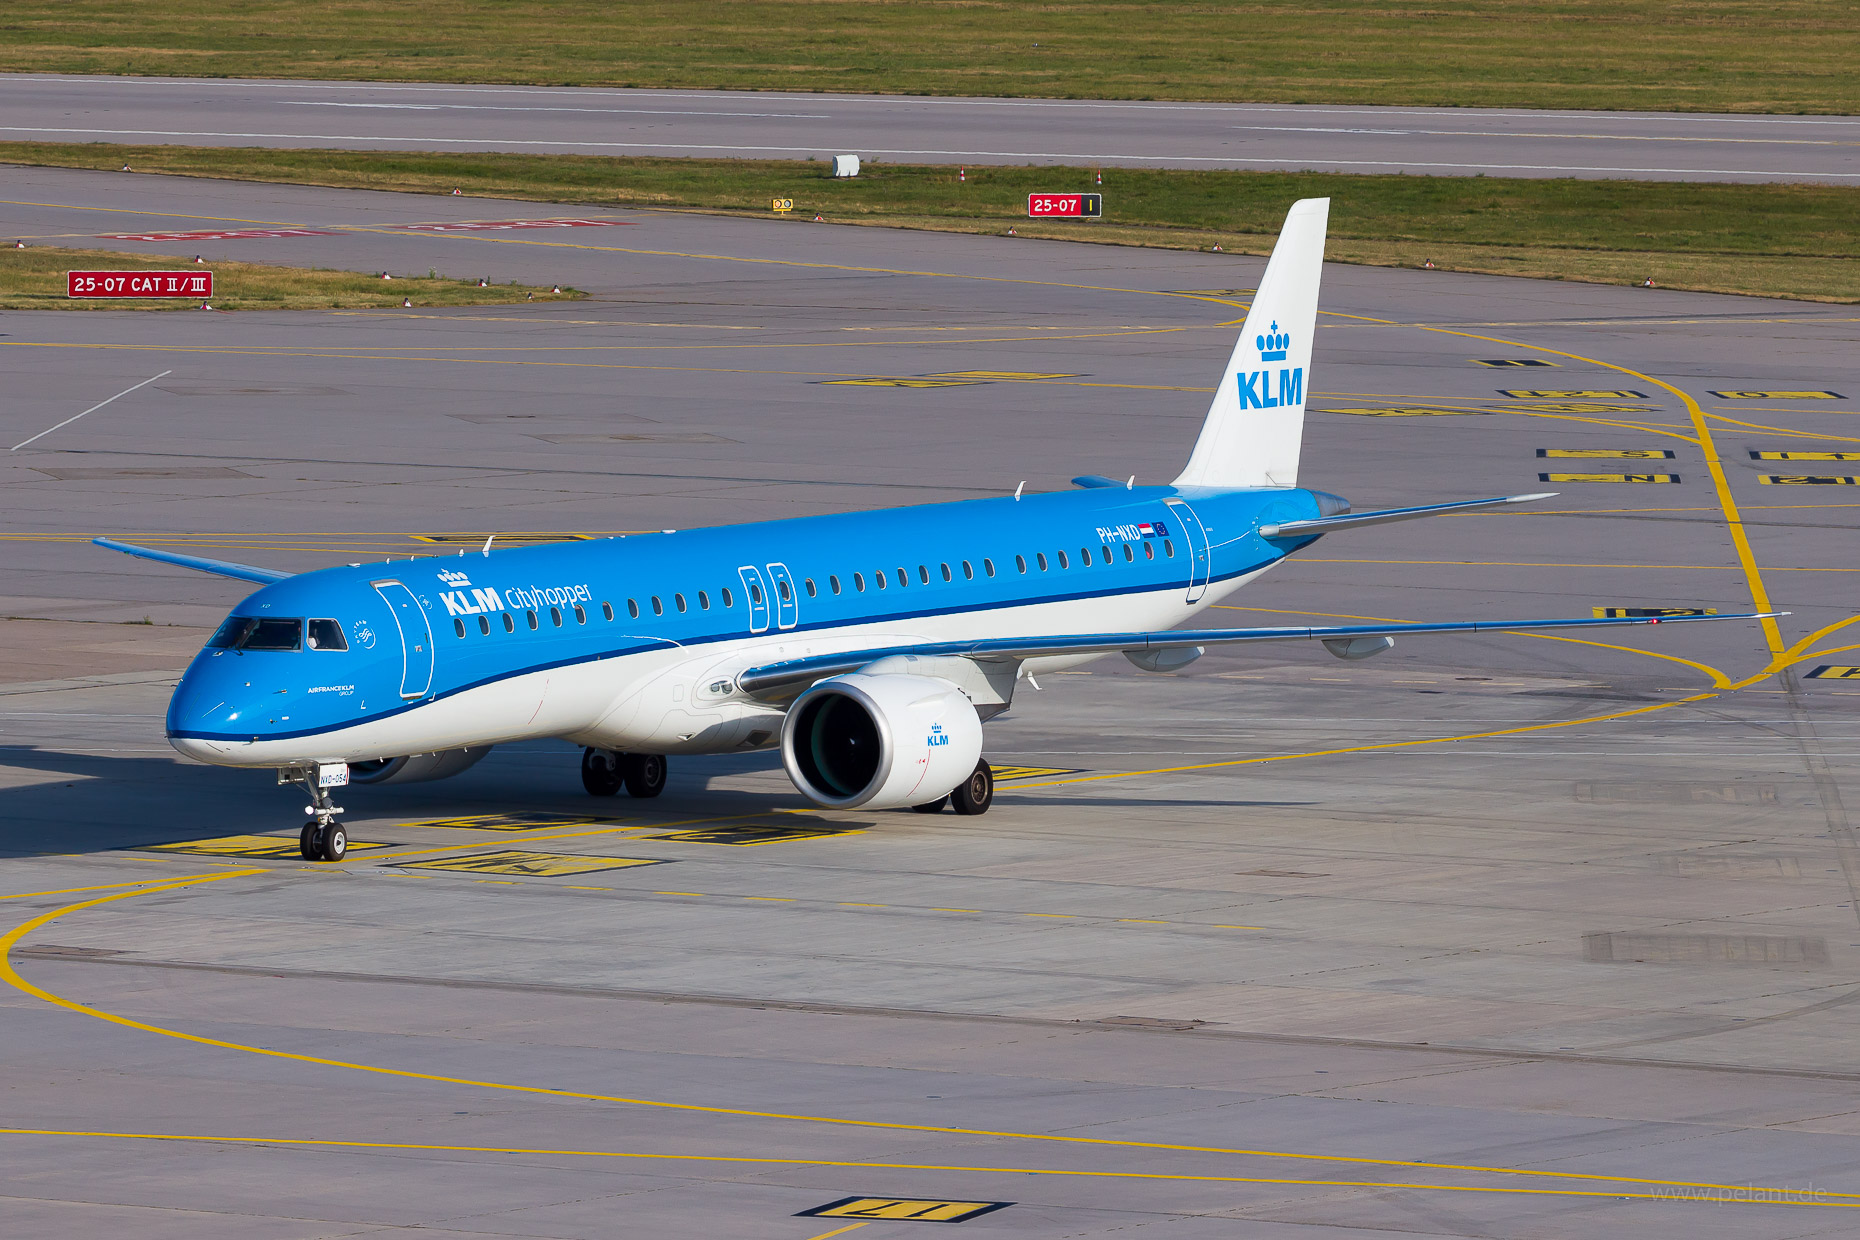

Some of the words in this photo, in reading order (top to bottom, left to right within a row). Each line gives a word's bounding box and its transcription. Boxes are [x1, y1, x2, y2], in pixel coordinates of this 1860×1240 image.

[1034, 199, 1077, 212] 25-07
[74, 277, 126, 292] 25-07
[131, 277, 162, 292] CAT
[166, 277, 207, 292] II/III
[1237, 367, 1303, 410] KLM
[1095, 524, 1141, 544] PH-NXD
[438, 587, 505, 616] KLM
[927, 735, 949, 747] KLM
